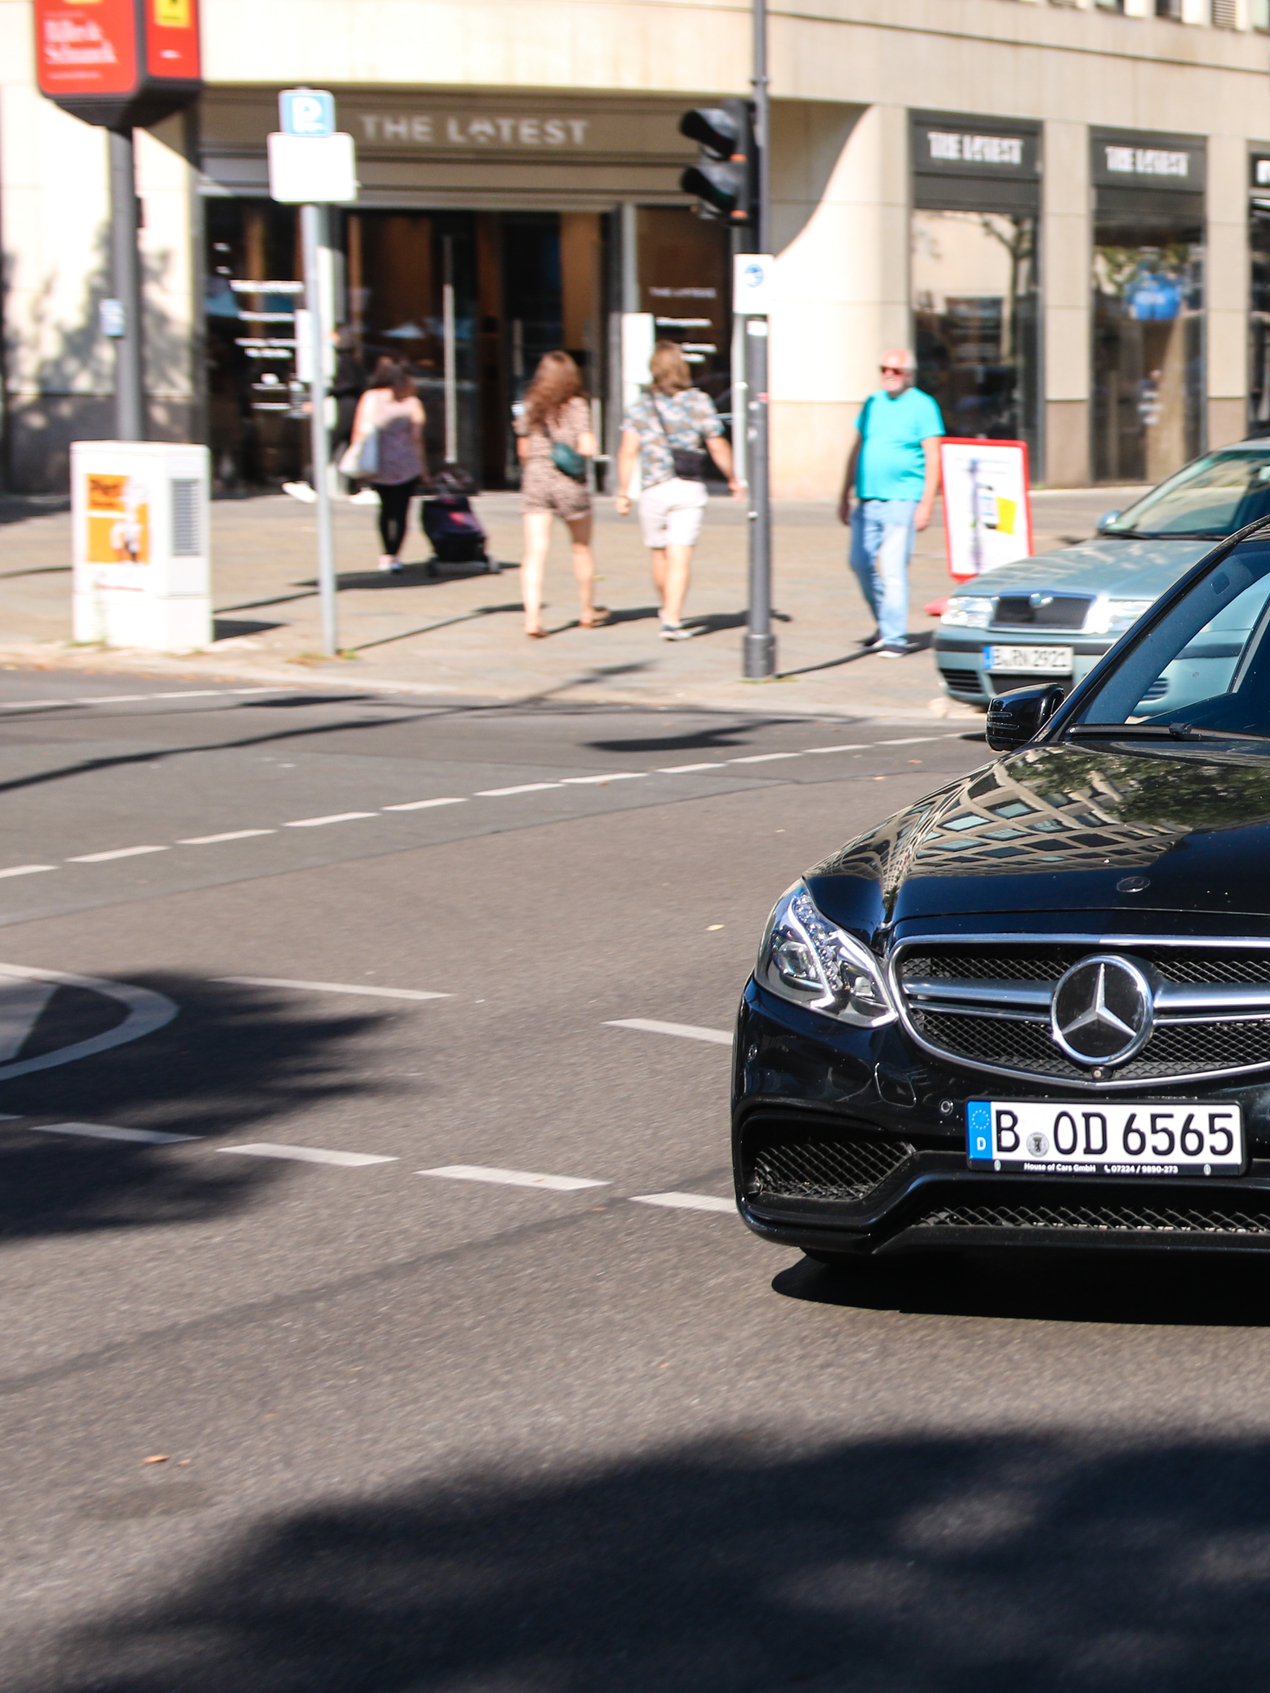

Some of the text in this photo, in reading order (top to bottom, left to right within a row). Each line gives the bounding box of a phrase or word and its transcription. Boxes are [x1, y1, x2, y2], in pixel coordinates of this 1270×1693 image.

[292, 97, 322, 132] P
[359, 115, 588, 145] THE LATEST
[928, 132, 962, 159] THE
[1105, 146, 1134, 172] THE
[976, 1137, 986, 1151] D
[995, 1110, 1233, 1156] B OD 6565
[1024, 1163, 1046, 1172] House
[1047, 1163, 1055, 1172] of
[1056, 1164, 1072, 1173] Cars
[1073, 1164, 1096, 1173] GmbH
[1111, 1165, 1135, 1174] 07224
[1142, 1165, 1179, 1175] 9890-273
